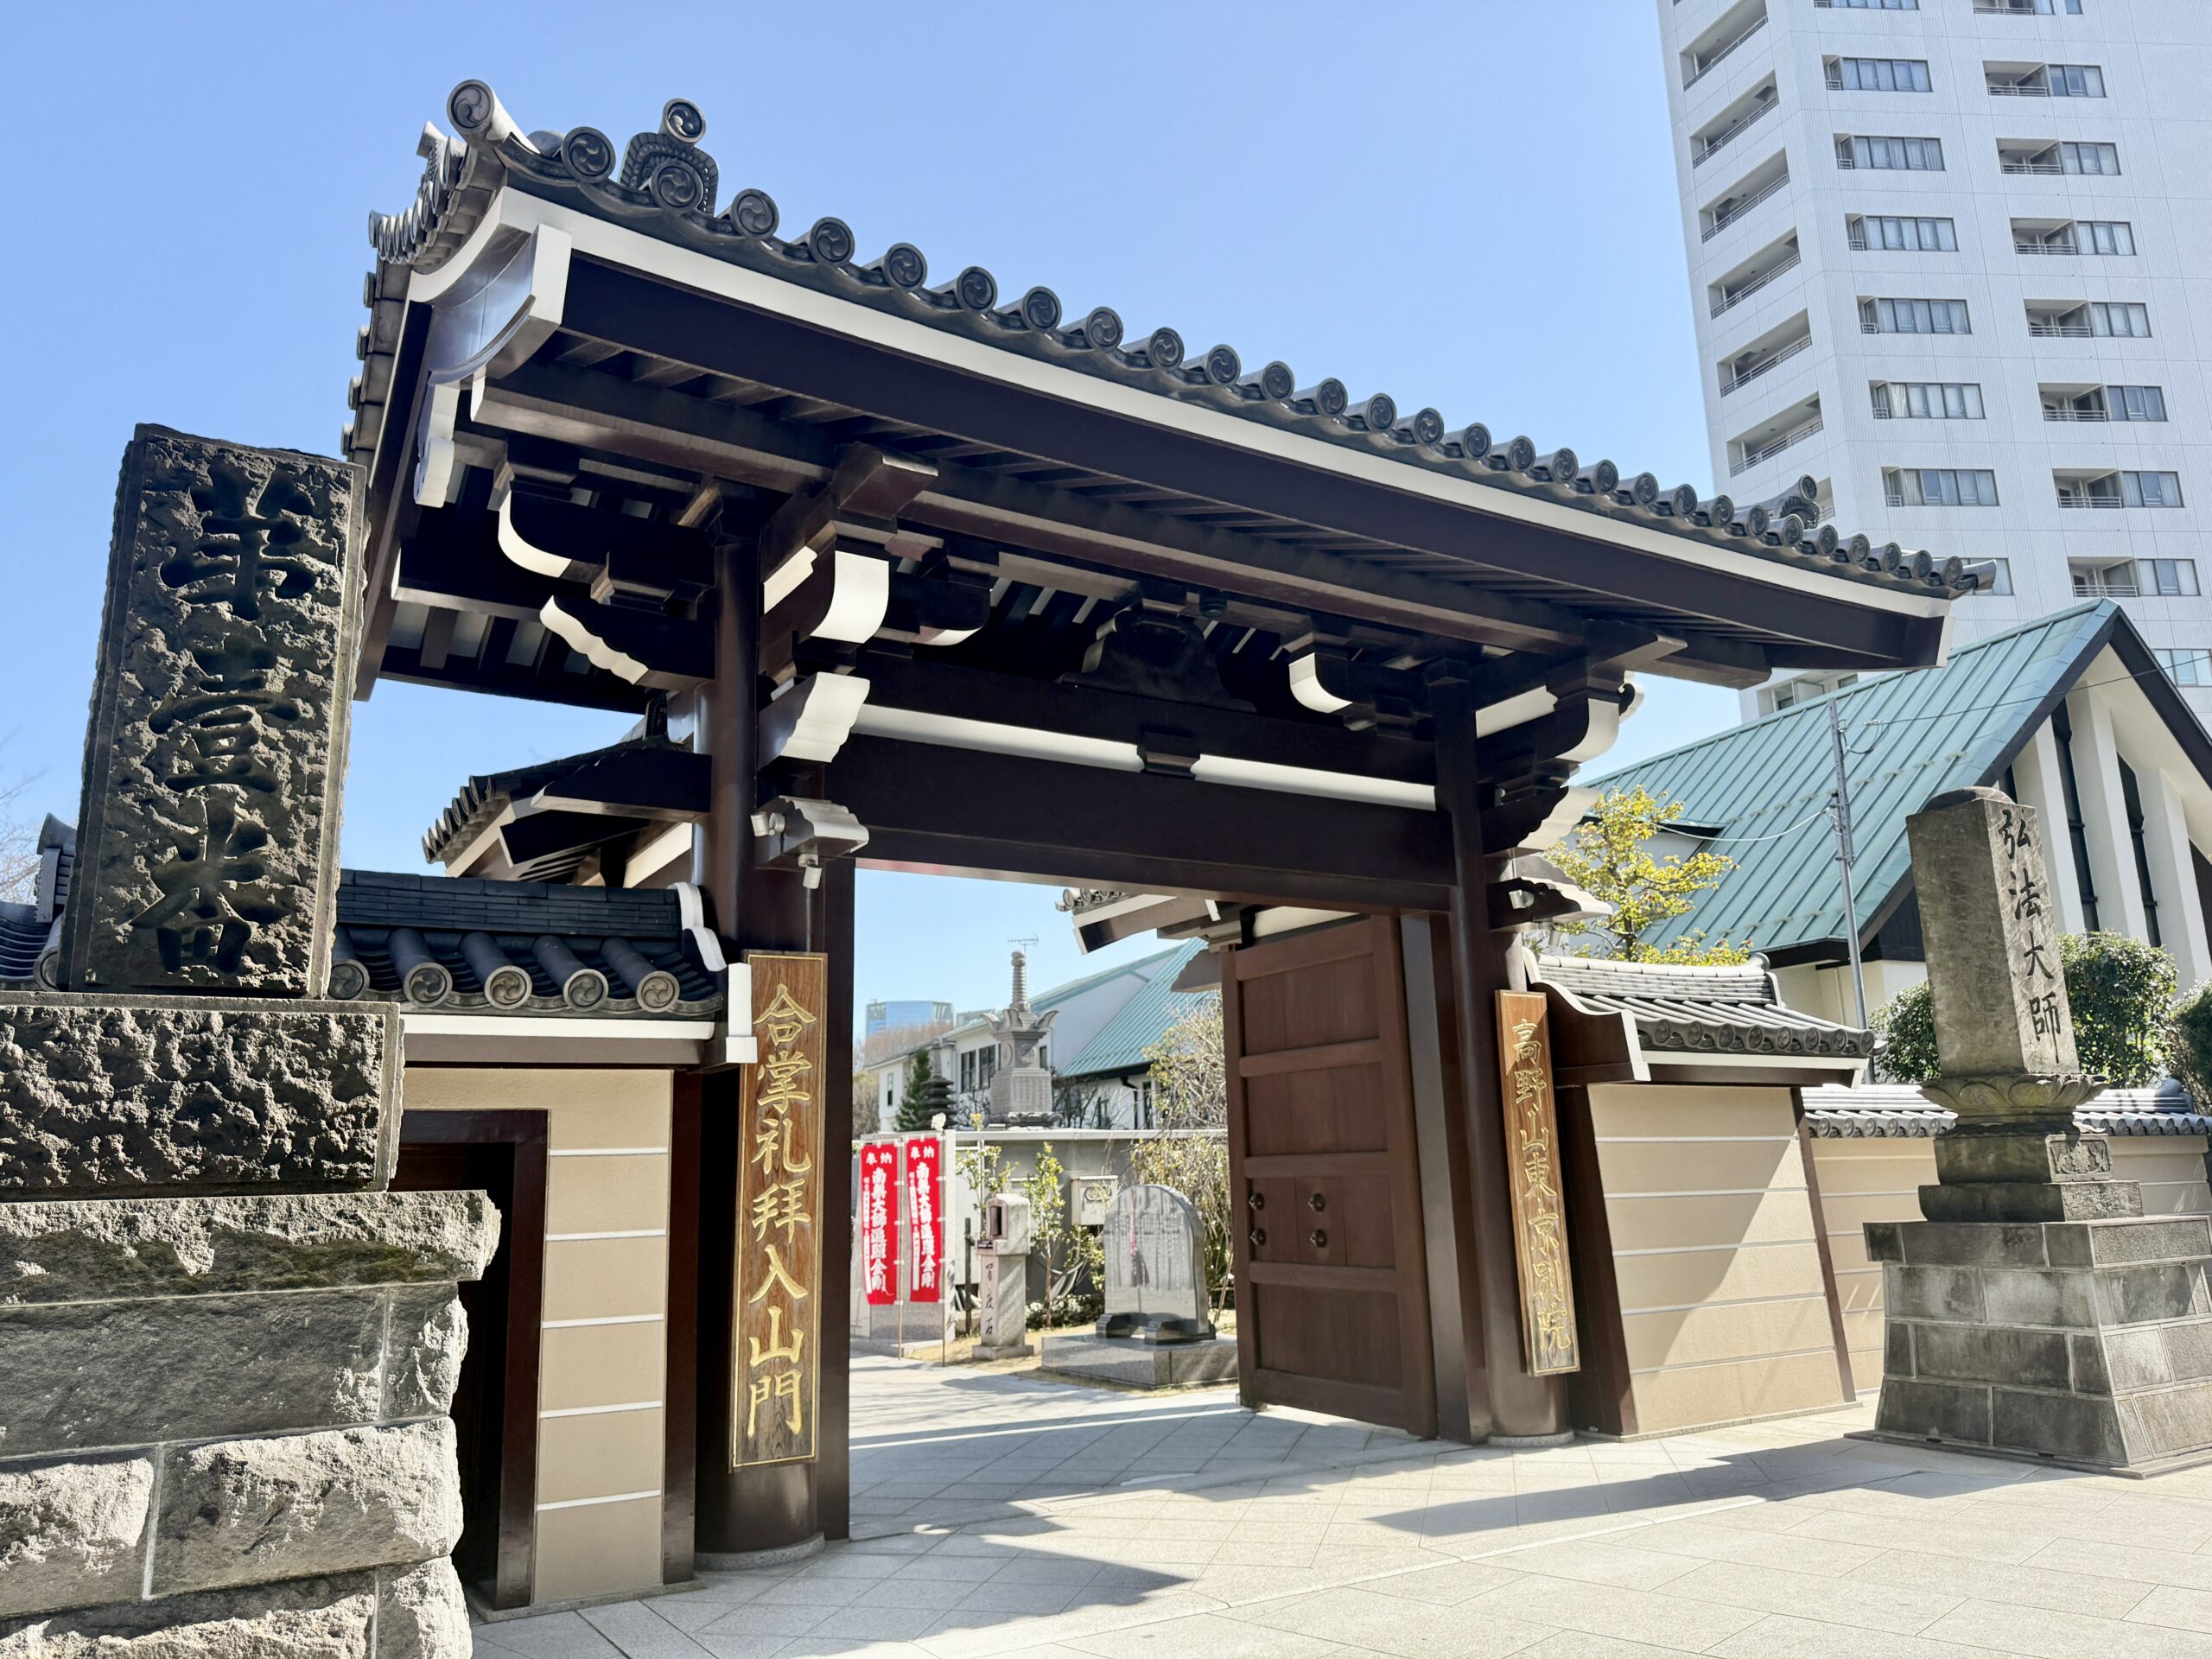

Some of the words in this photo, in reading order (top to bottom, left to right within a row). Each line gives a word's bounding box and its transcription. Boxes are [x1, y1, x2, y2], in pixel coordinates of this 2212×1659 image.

[1998, 808, 2062, 1065] 弘法大師
[747, 983, 818, 1438] 合掌礼拝入山門
[1512, 1018, 1572, 1351] 高野山東京別院
